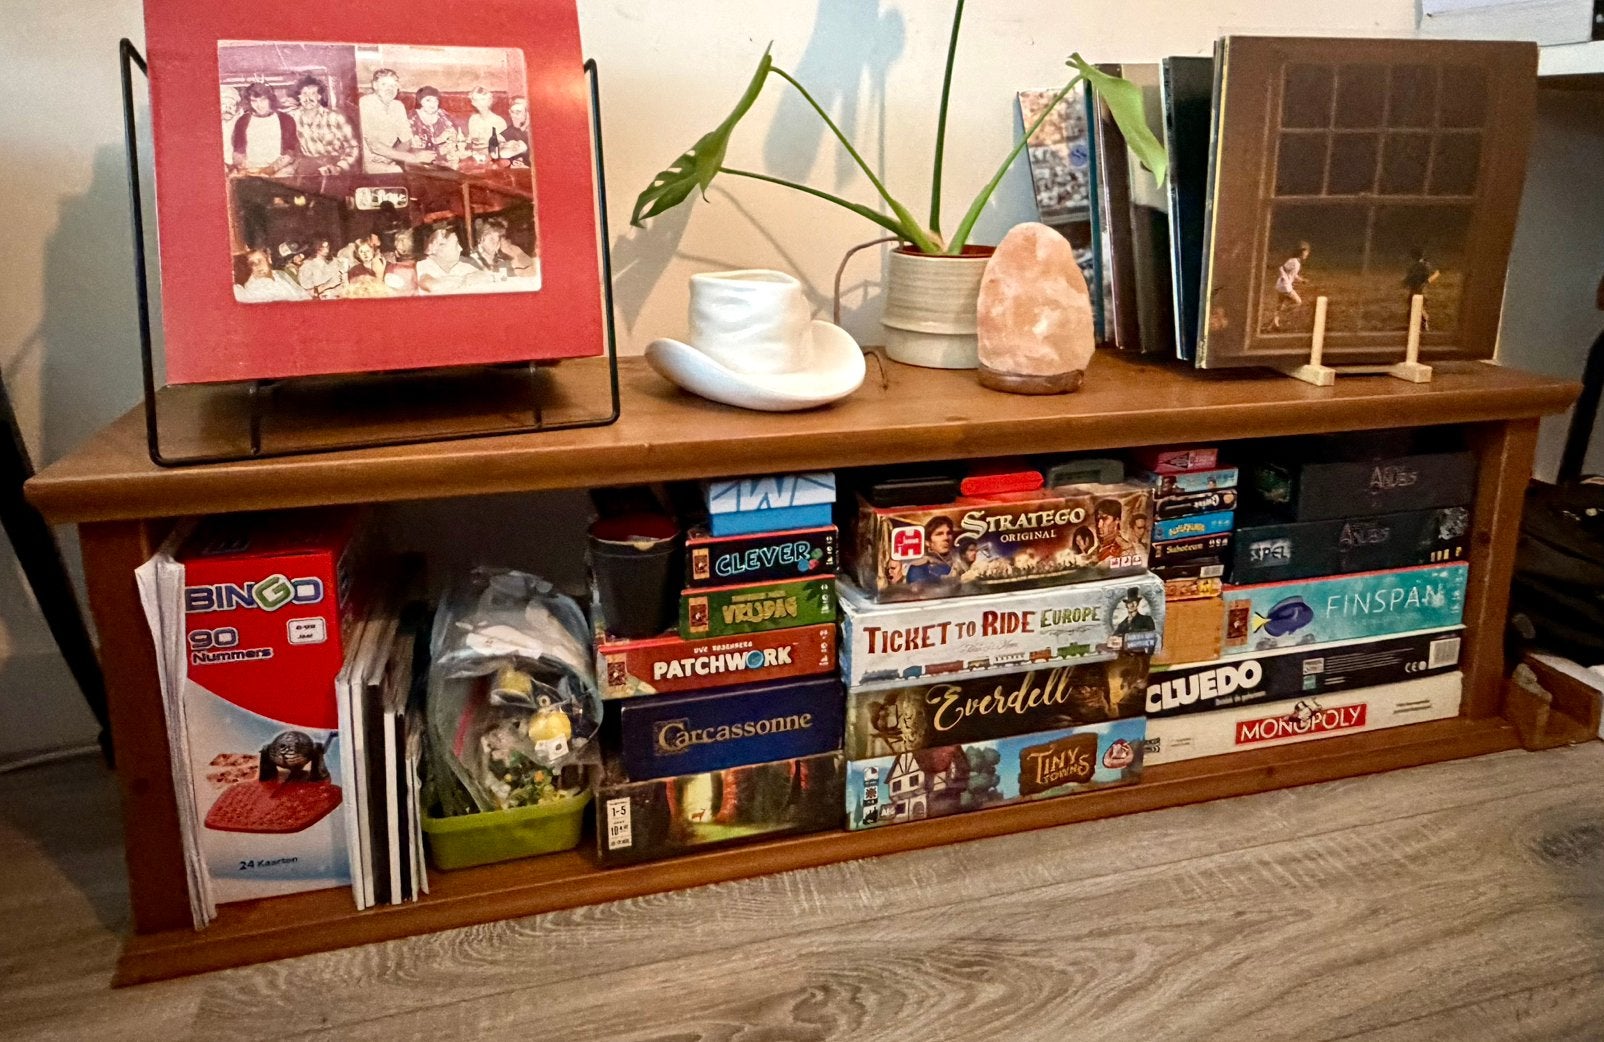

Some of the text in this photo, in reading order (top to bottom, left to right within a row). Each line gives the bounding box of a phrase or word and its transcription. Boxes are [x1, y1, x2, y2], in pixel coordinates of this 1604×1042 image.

[954, 507, 1087, 547] STRATEGO
[1000, 529, 1057, 544] ORIGINAL
[715, 541, 811, 577] CLEVER
[185, 574, 324, 612] BINGO
[722, 596, 798, 625] VRIJDAG
[1326, 583, 1444, 618] FINSPAN
[189, 627, 238, 649] 90
[863, 621, 951, 655] TICKET
[982, 610, 1036, 638] RIDE
[1040, 605, 1101, 629] EUROPE
[193, 647, 273, 665] Nummers
[653, 645, 792, 681] PATCHWORK
[926, 666, 1073, 731] Everdell
[1145, 660, 1263, 713] CLUEDO
[658, 712, 813, 751] Carcassonne
[1240, 706, 1360, 742] MONOPOLY
[1027, 744, 1080, 785] TINY
[612, 806, 626, 817] 1-5
[611, 826, 619, 836] 10
[240, 856, 298, 870] 24 Kaarten
